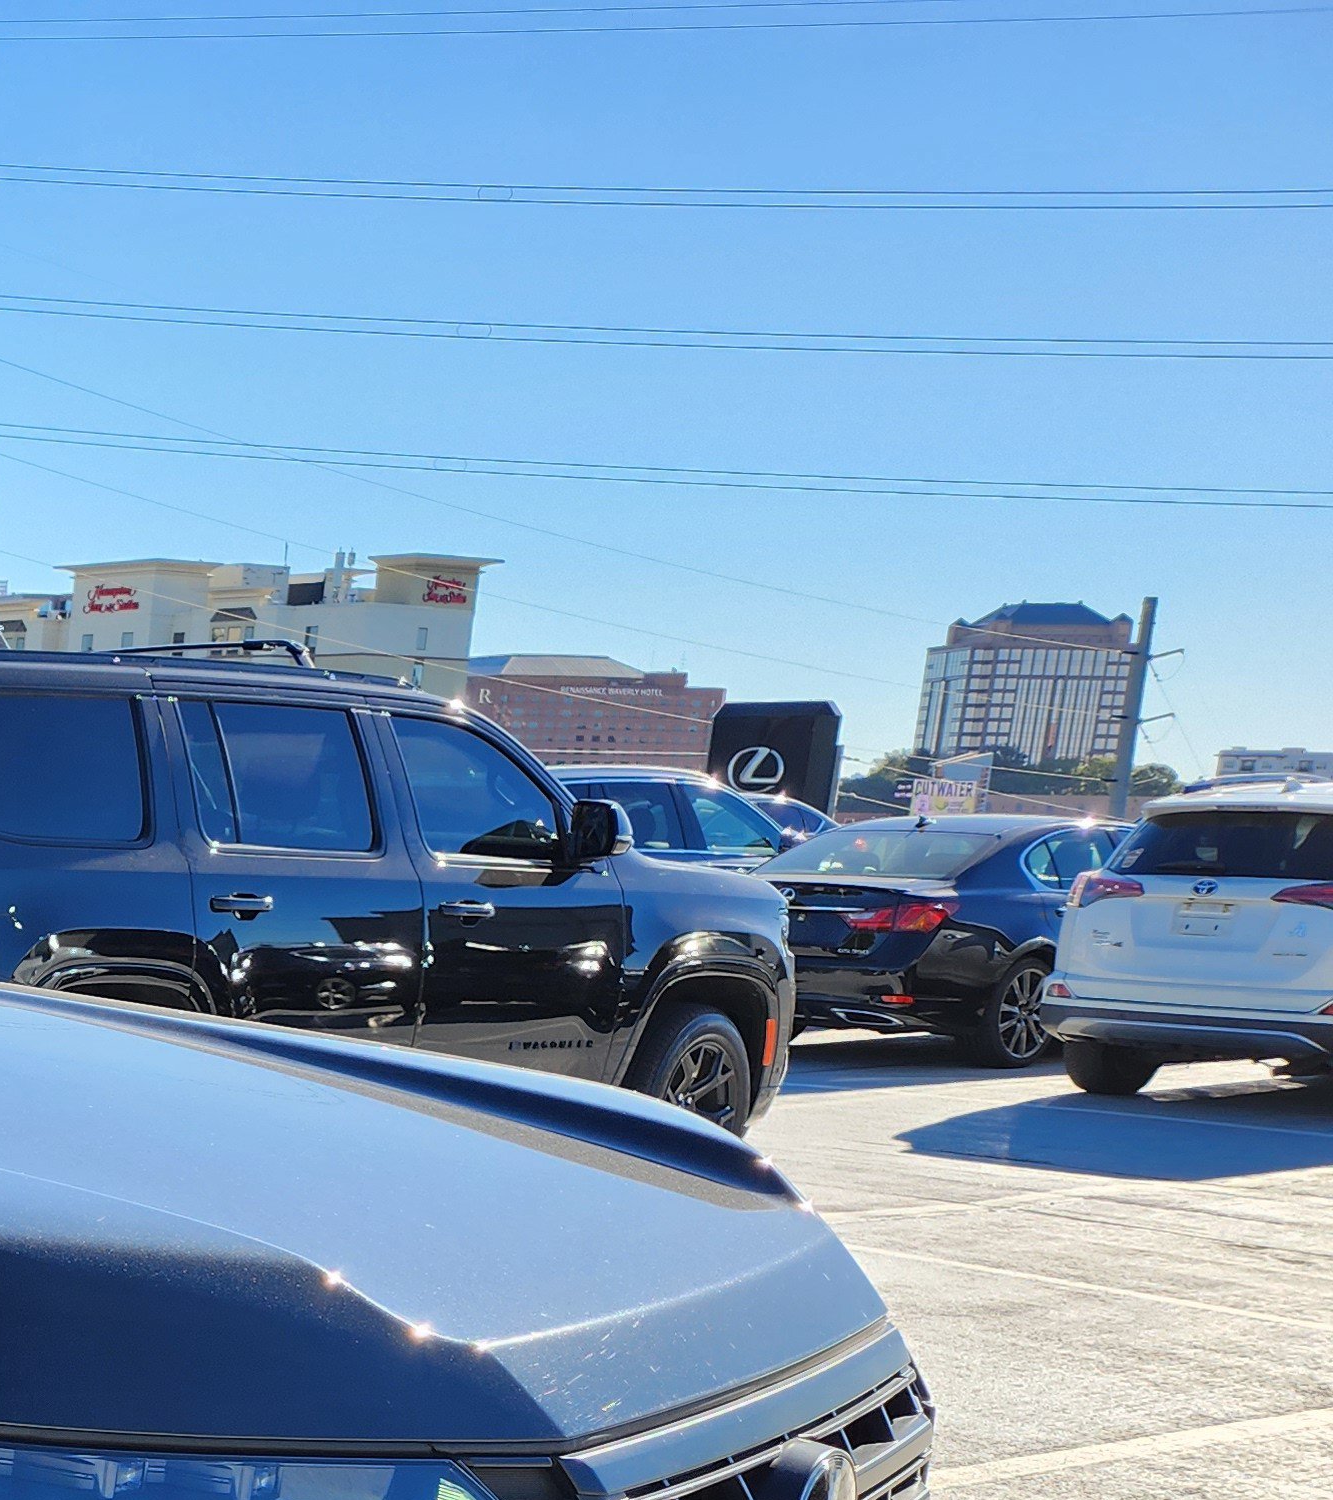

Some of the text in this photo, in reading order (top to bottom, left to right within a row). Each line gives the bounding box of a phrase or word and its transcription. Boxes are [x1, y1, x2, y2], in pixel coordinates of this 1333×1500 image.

[478, 688, 493, 705] R
[560, 686, 663, 697] RENAISSANCE WAVERLY HOTEL
